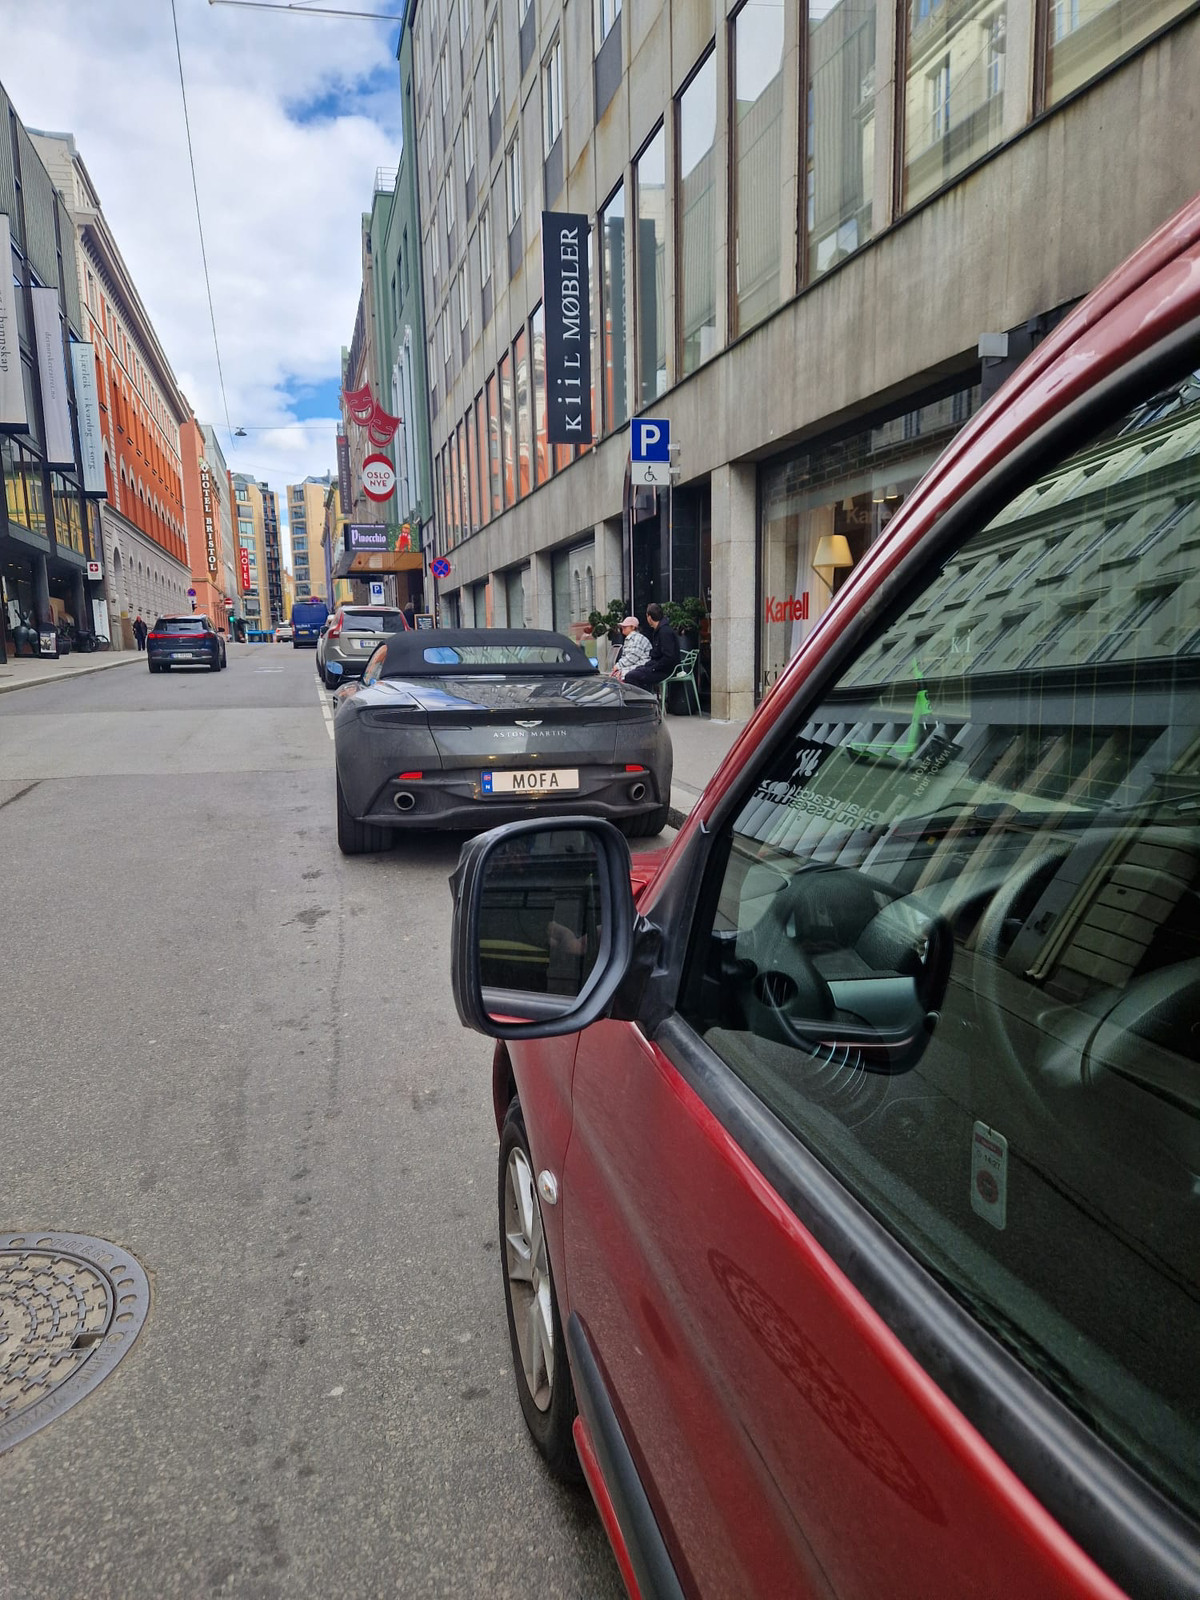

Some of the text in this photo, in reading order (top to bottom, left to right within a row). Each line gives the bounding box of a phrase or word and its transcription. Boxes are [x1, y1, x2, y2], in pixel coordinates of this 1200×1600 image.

[560, 226, 582, 341] MØBLER
[640, 423, 661, 457] P
[366, 471, 390, 479] OSLO
[201, 473, 216, 571] HOTEL BRISTOL
[351, 529, 387, 545] Pinocchio
[241, 550, 249, 587] HOTEL
[765, 591, 810, 624] Kartell
[531, 729, 567, 737] MARTIN
[512, 772, 559, 789] MOFA
